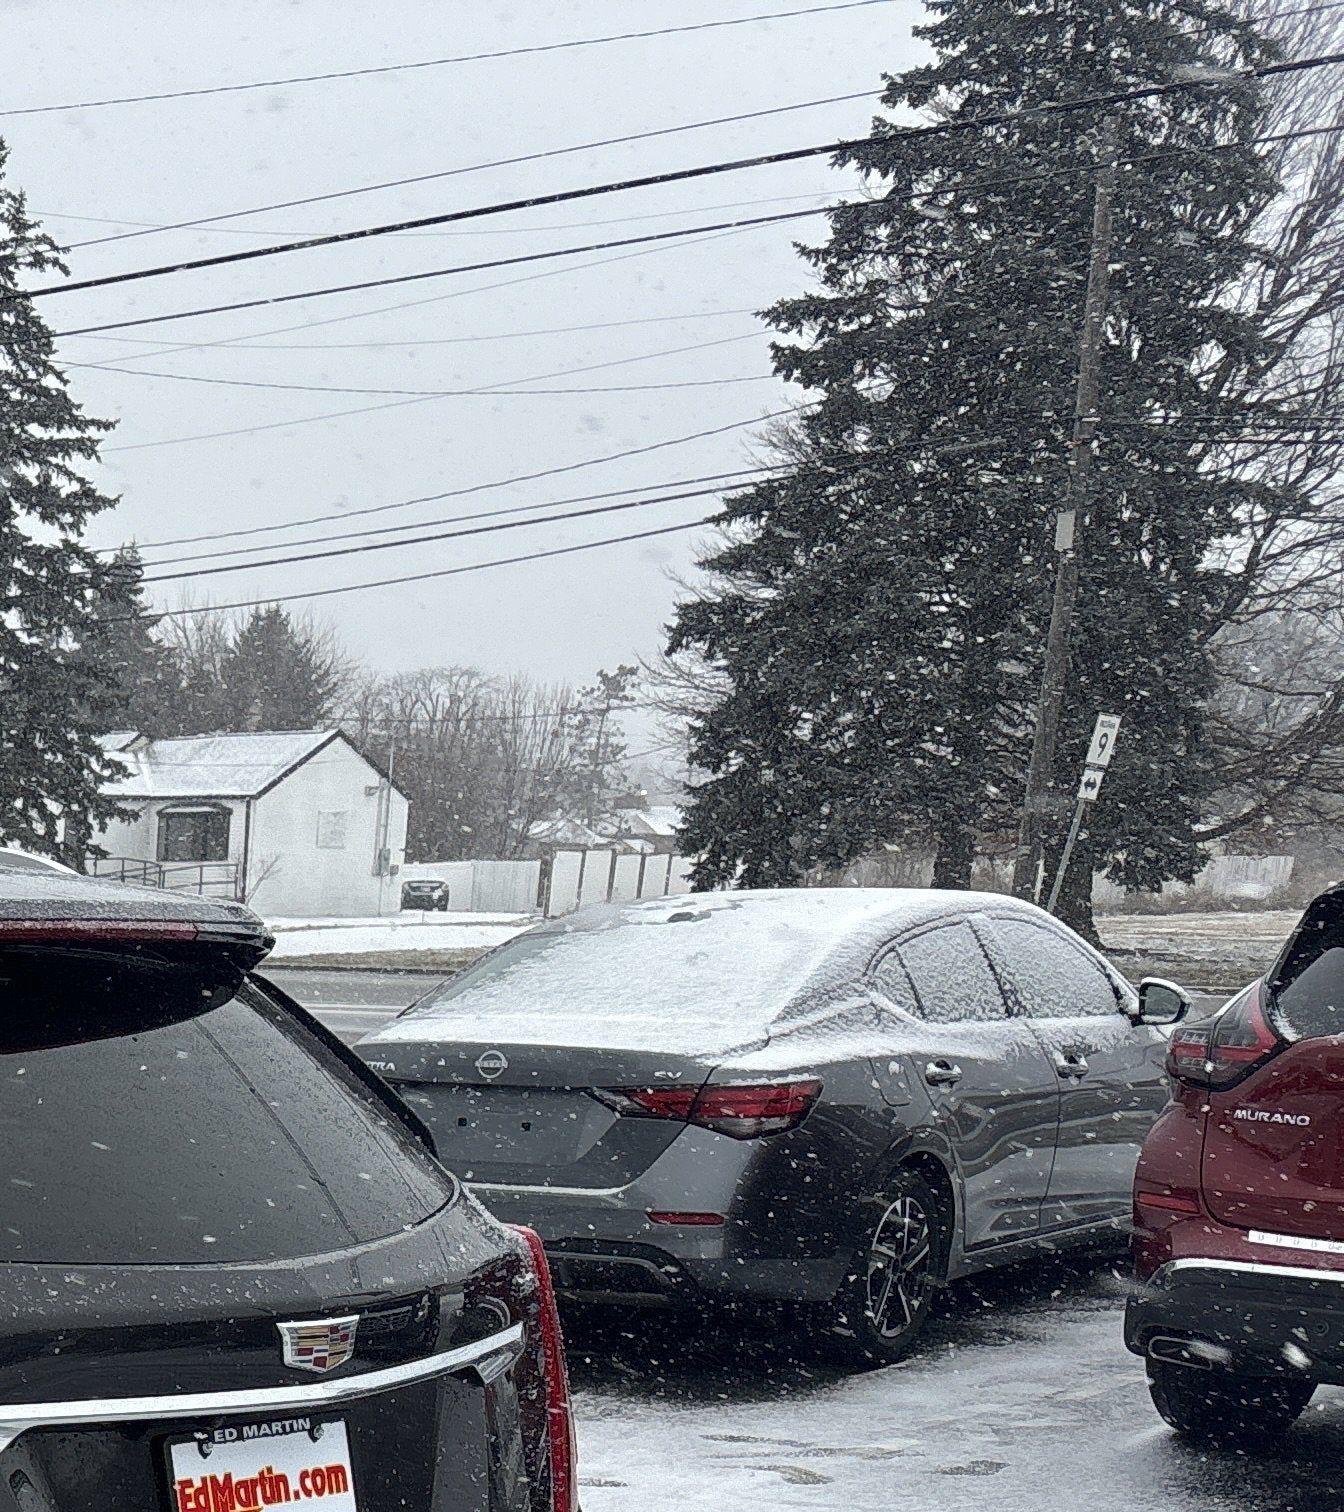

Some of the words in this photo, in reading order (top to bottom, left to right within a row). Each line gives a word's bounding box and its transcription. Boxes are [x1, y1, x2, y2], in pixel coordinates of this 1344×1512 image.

[1097, 731, 1110, 759] 9
[1233, 1108, 1311, 1126] MURANO
[213, 1427, 237, 1443] ED
[242, 1417, 311, 1440] MARTIN
